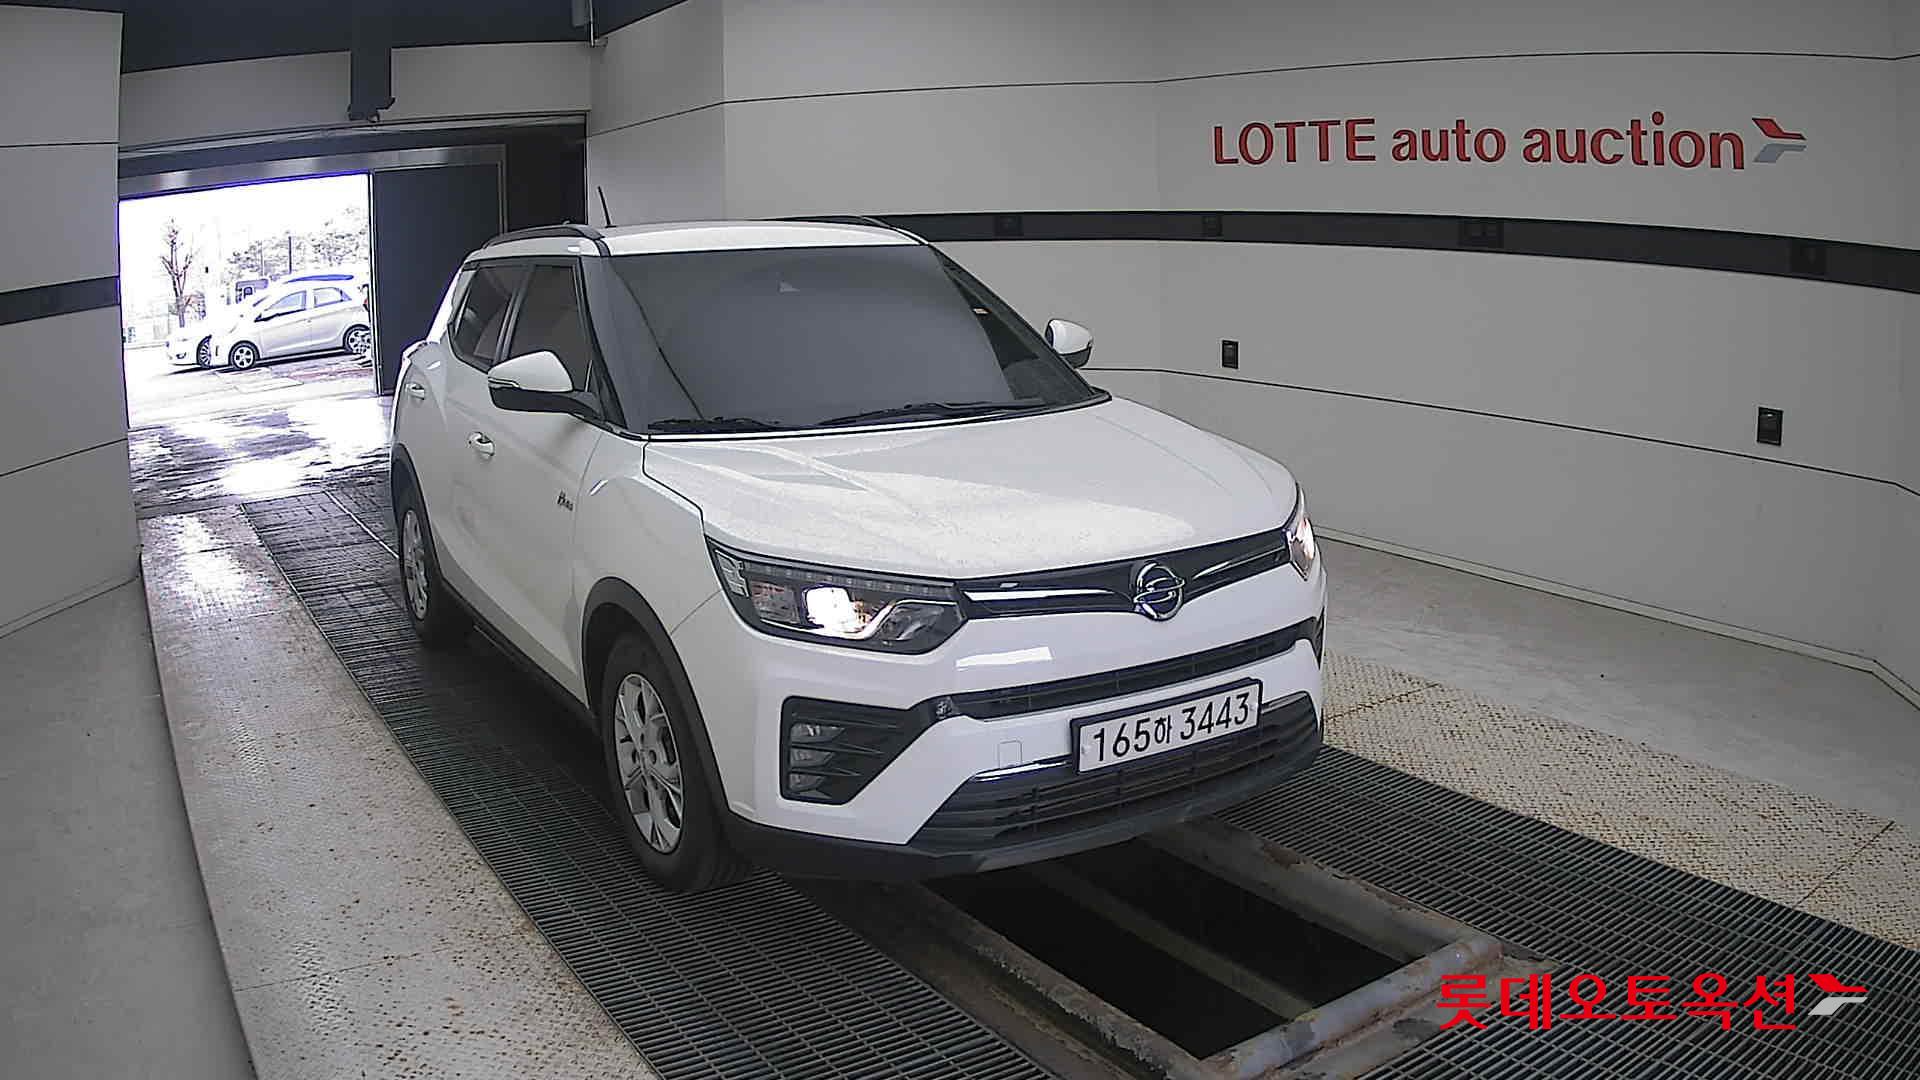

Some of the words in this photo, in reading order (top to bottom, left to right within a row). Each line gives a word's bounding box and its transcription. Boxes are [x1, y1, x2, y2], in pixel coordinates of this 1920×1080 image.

[1212, 117, 1376, 165] LOTTE
[1391, 119, 1507, 164] auto
[1522, 111, 1746, 171] auction
[1093, 714, 1173, 762] 165하
[1180, 692, 1250, 741] 3443
